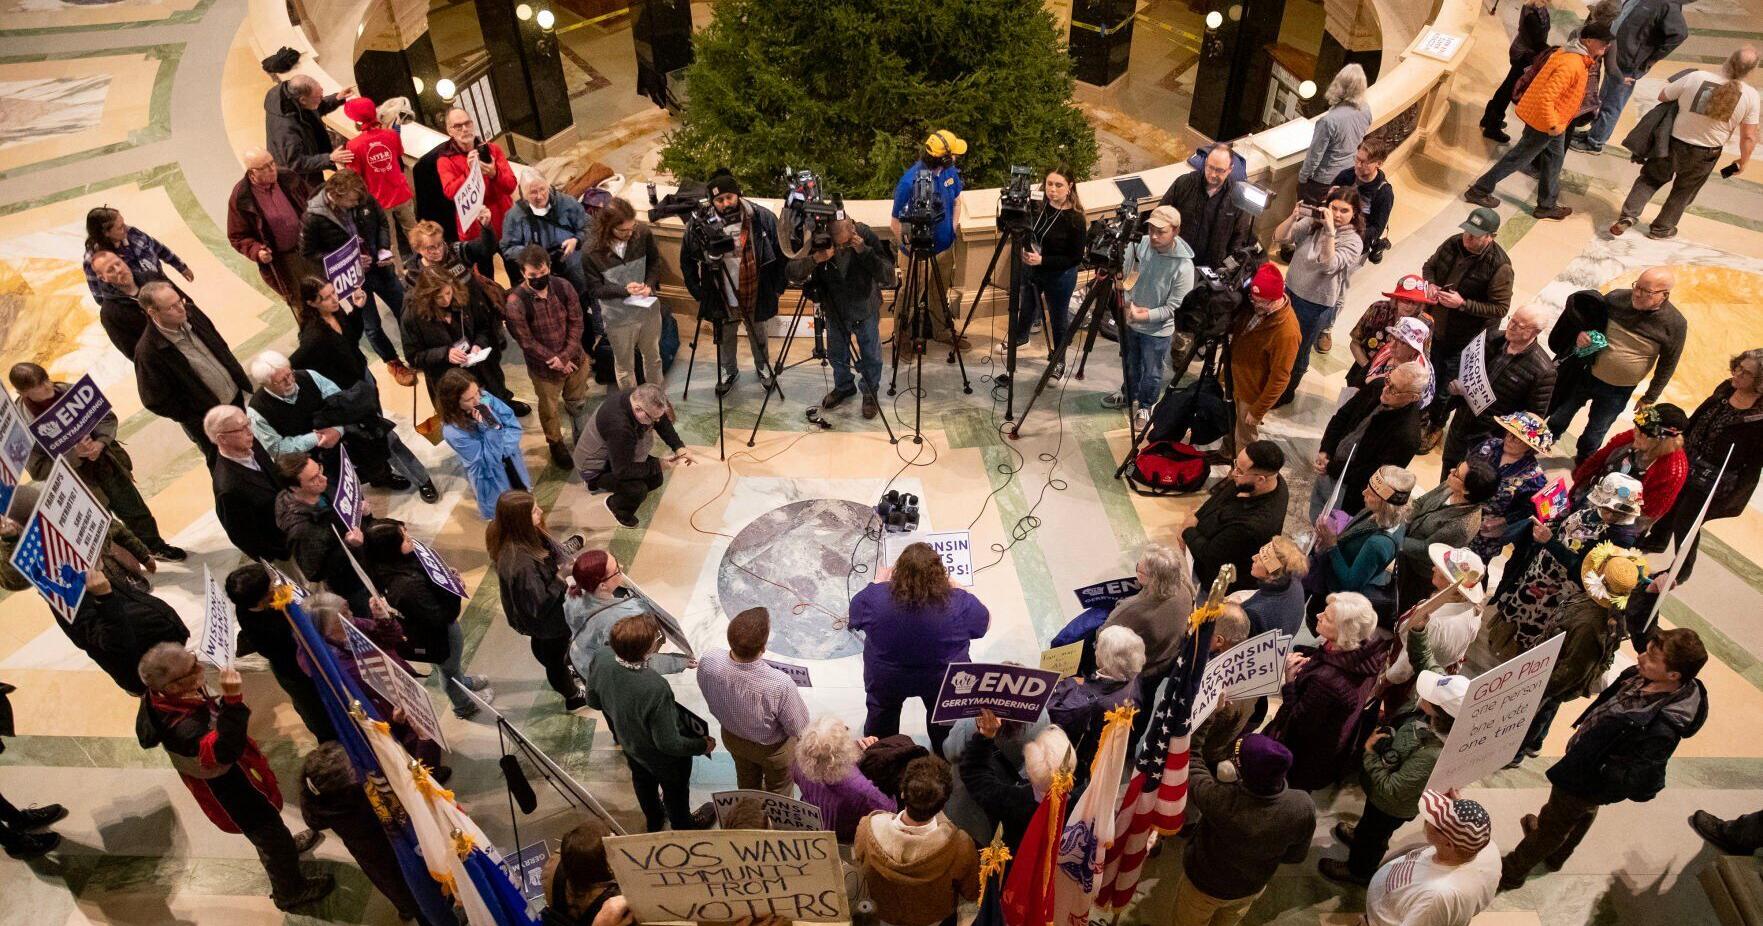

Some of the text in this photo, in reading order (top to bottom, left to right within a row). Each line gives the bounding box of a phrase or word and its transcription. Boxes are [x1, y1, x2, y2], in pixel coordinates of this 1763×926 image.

[333, 265, 358, 294] END
[1468, 353, 1480, 395] WANTS
[1475, 336, 1491, 404] WISCONSIN
[55, 385, 95, 427] END
[1463, 375, 1481, 410] MAPS!
[49, 397, 105, 450] GERRYMANDERING!
[44, 472, 64, 510] FAIR MAPS
[343, 458, 354, 501] END
[57, 491, 66, 507] ARE
[75, 507, 93, 546] DEMOCRACY
[86, 519, 106, 562] GERRYMANDER
[1106, 580, 1141, 594] EN
[206, 576, 217, 656] WISCONSIN
[1201, 639, 1274, 689] ISCONSIN
[1203, 657, 1256, 696] WANTS
[1473, 656, 1550, 701] GOP Plan
[977, 672, 1047, 697] END
[1192, 662, 1273, 719] FAIR MAPS!
[1471, 679, 1543, 719] one person
[941, 697, 1040, 711] GERRYMANDERING!
[1469, 703, 1529, 736] one vote
[1458, 717, 1526, 753] one time
[716, 797, 819, 819] WIONSIN
[620, 837, 828, 870] VOS WANTS
[657, 889, 840, 919] VOTERS
[705, 876, 787, 897] FROM
